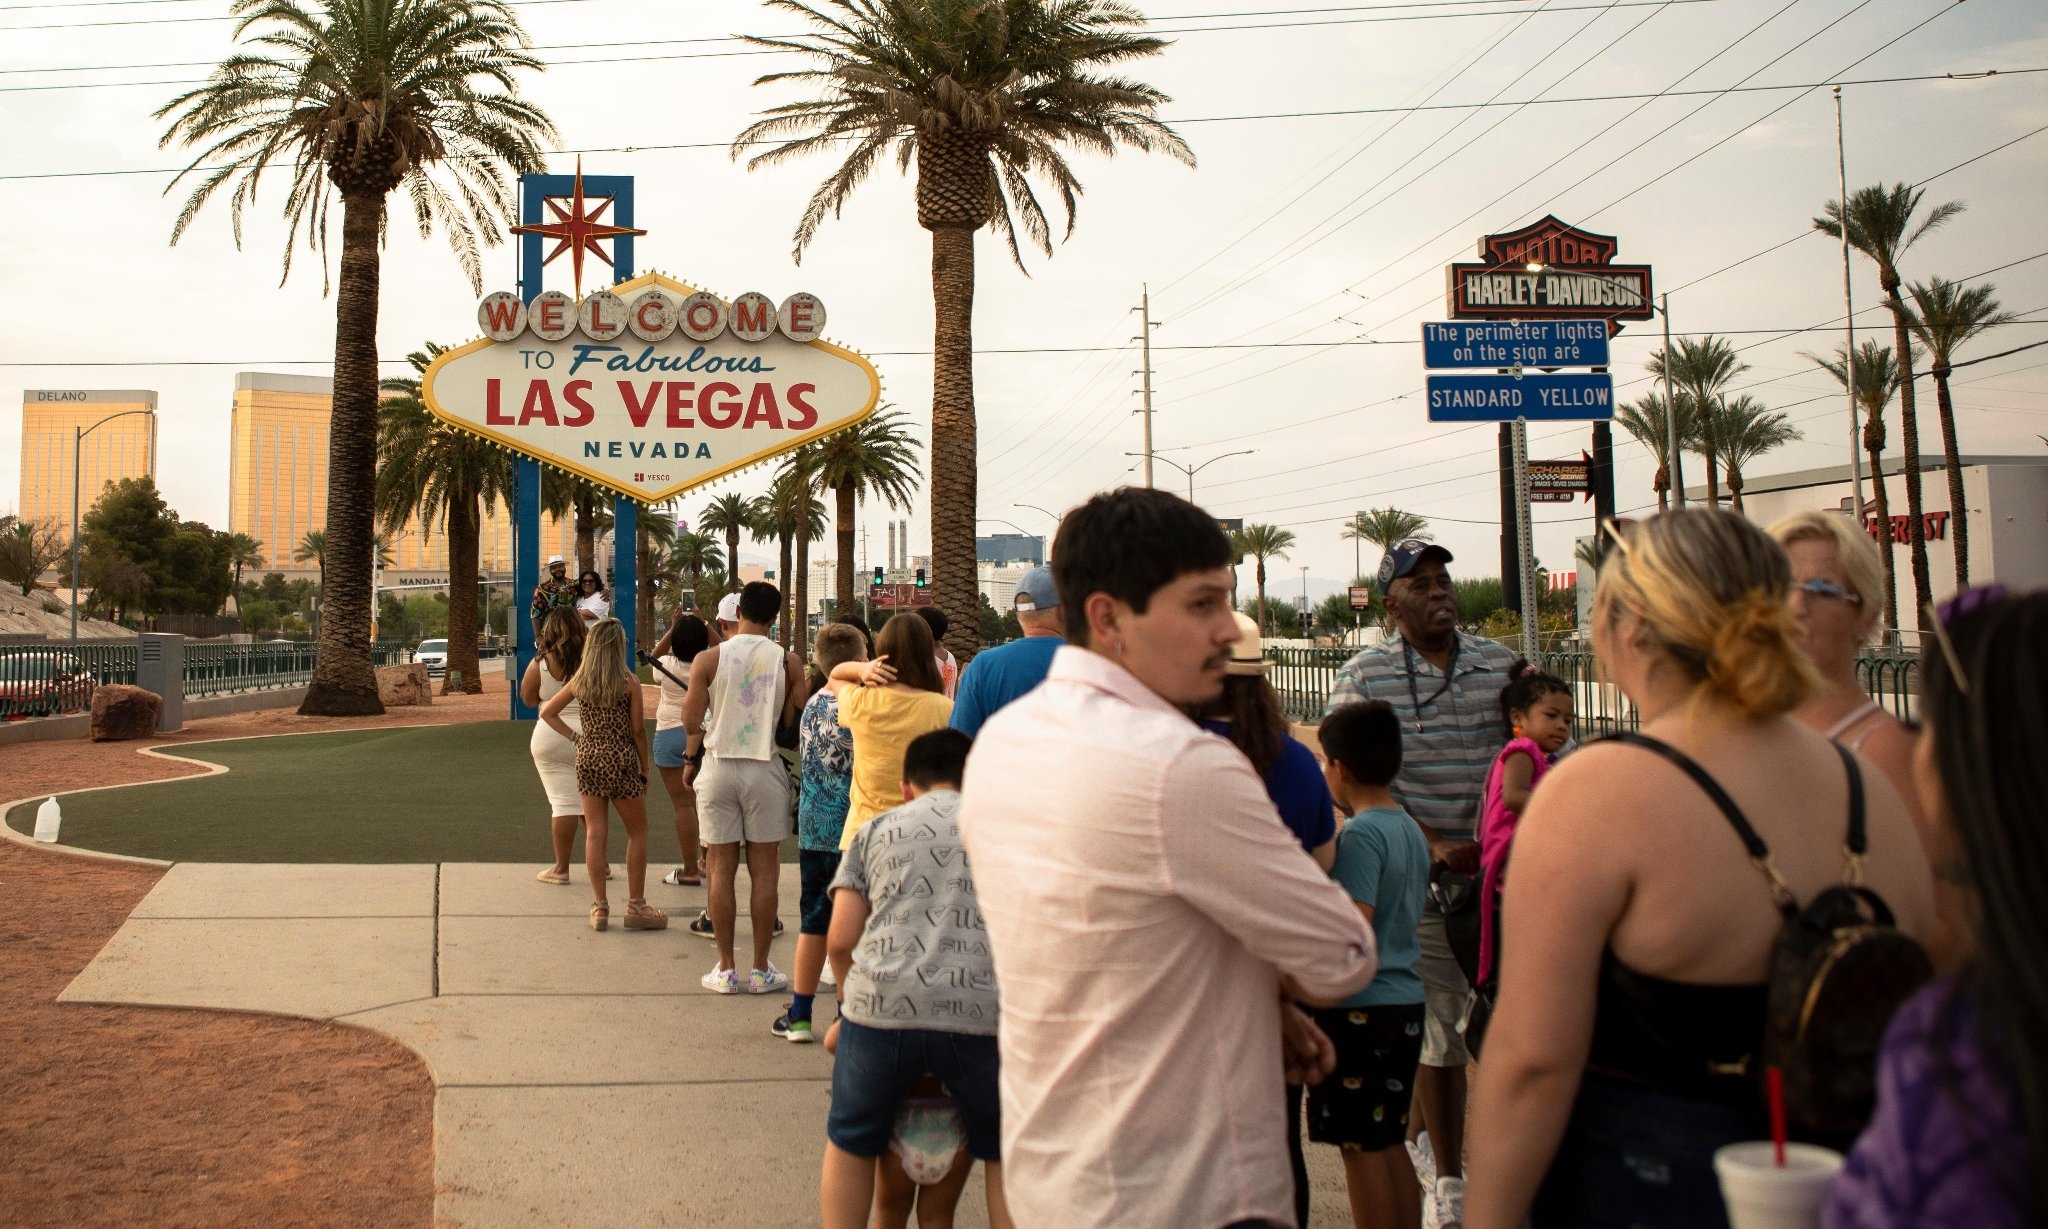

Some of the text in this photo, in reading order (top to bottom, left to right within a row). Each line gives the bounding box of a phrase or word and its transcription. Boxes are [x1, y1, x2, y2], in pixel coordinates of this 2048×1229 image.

[1506, 230, 1599, 264] MOTOR
[1466, 274, 1642, 306] HARLEY-DAVIDSON
[484, 301, 814, 334] WELCOME
[1427, 322, 1603, 345] The perimeter lights
[519, 344, 777, 376] TO Fabulous
[1453, 344, 1580, 365] on the sign are
[38, 391, 87, 402] DELANO
[485, 379, 819, 431] LAS VEGAS
[1431, 388, 1609, 408] STANDARD YELLOW
[583, 440, 713, 460] NEVADA
[647, 474, 671, 482] YESCO
[1529, 466, 1587, 474] ECHARGE
[1868, 511, 1949, 545] HERST
[874, 588, 896, 597] TAO
[938, 937, 989, 956] FILA
[851, 992, 918, 1020] FILA
[932, 1001, 985, 1019] FILA
